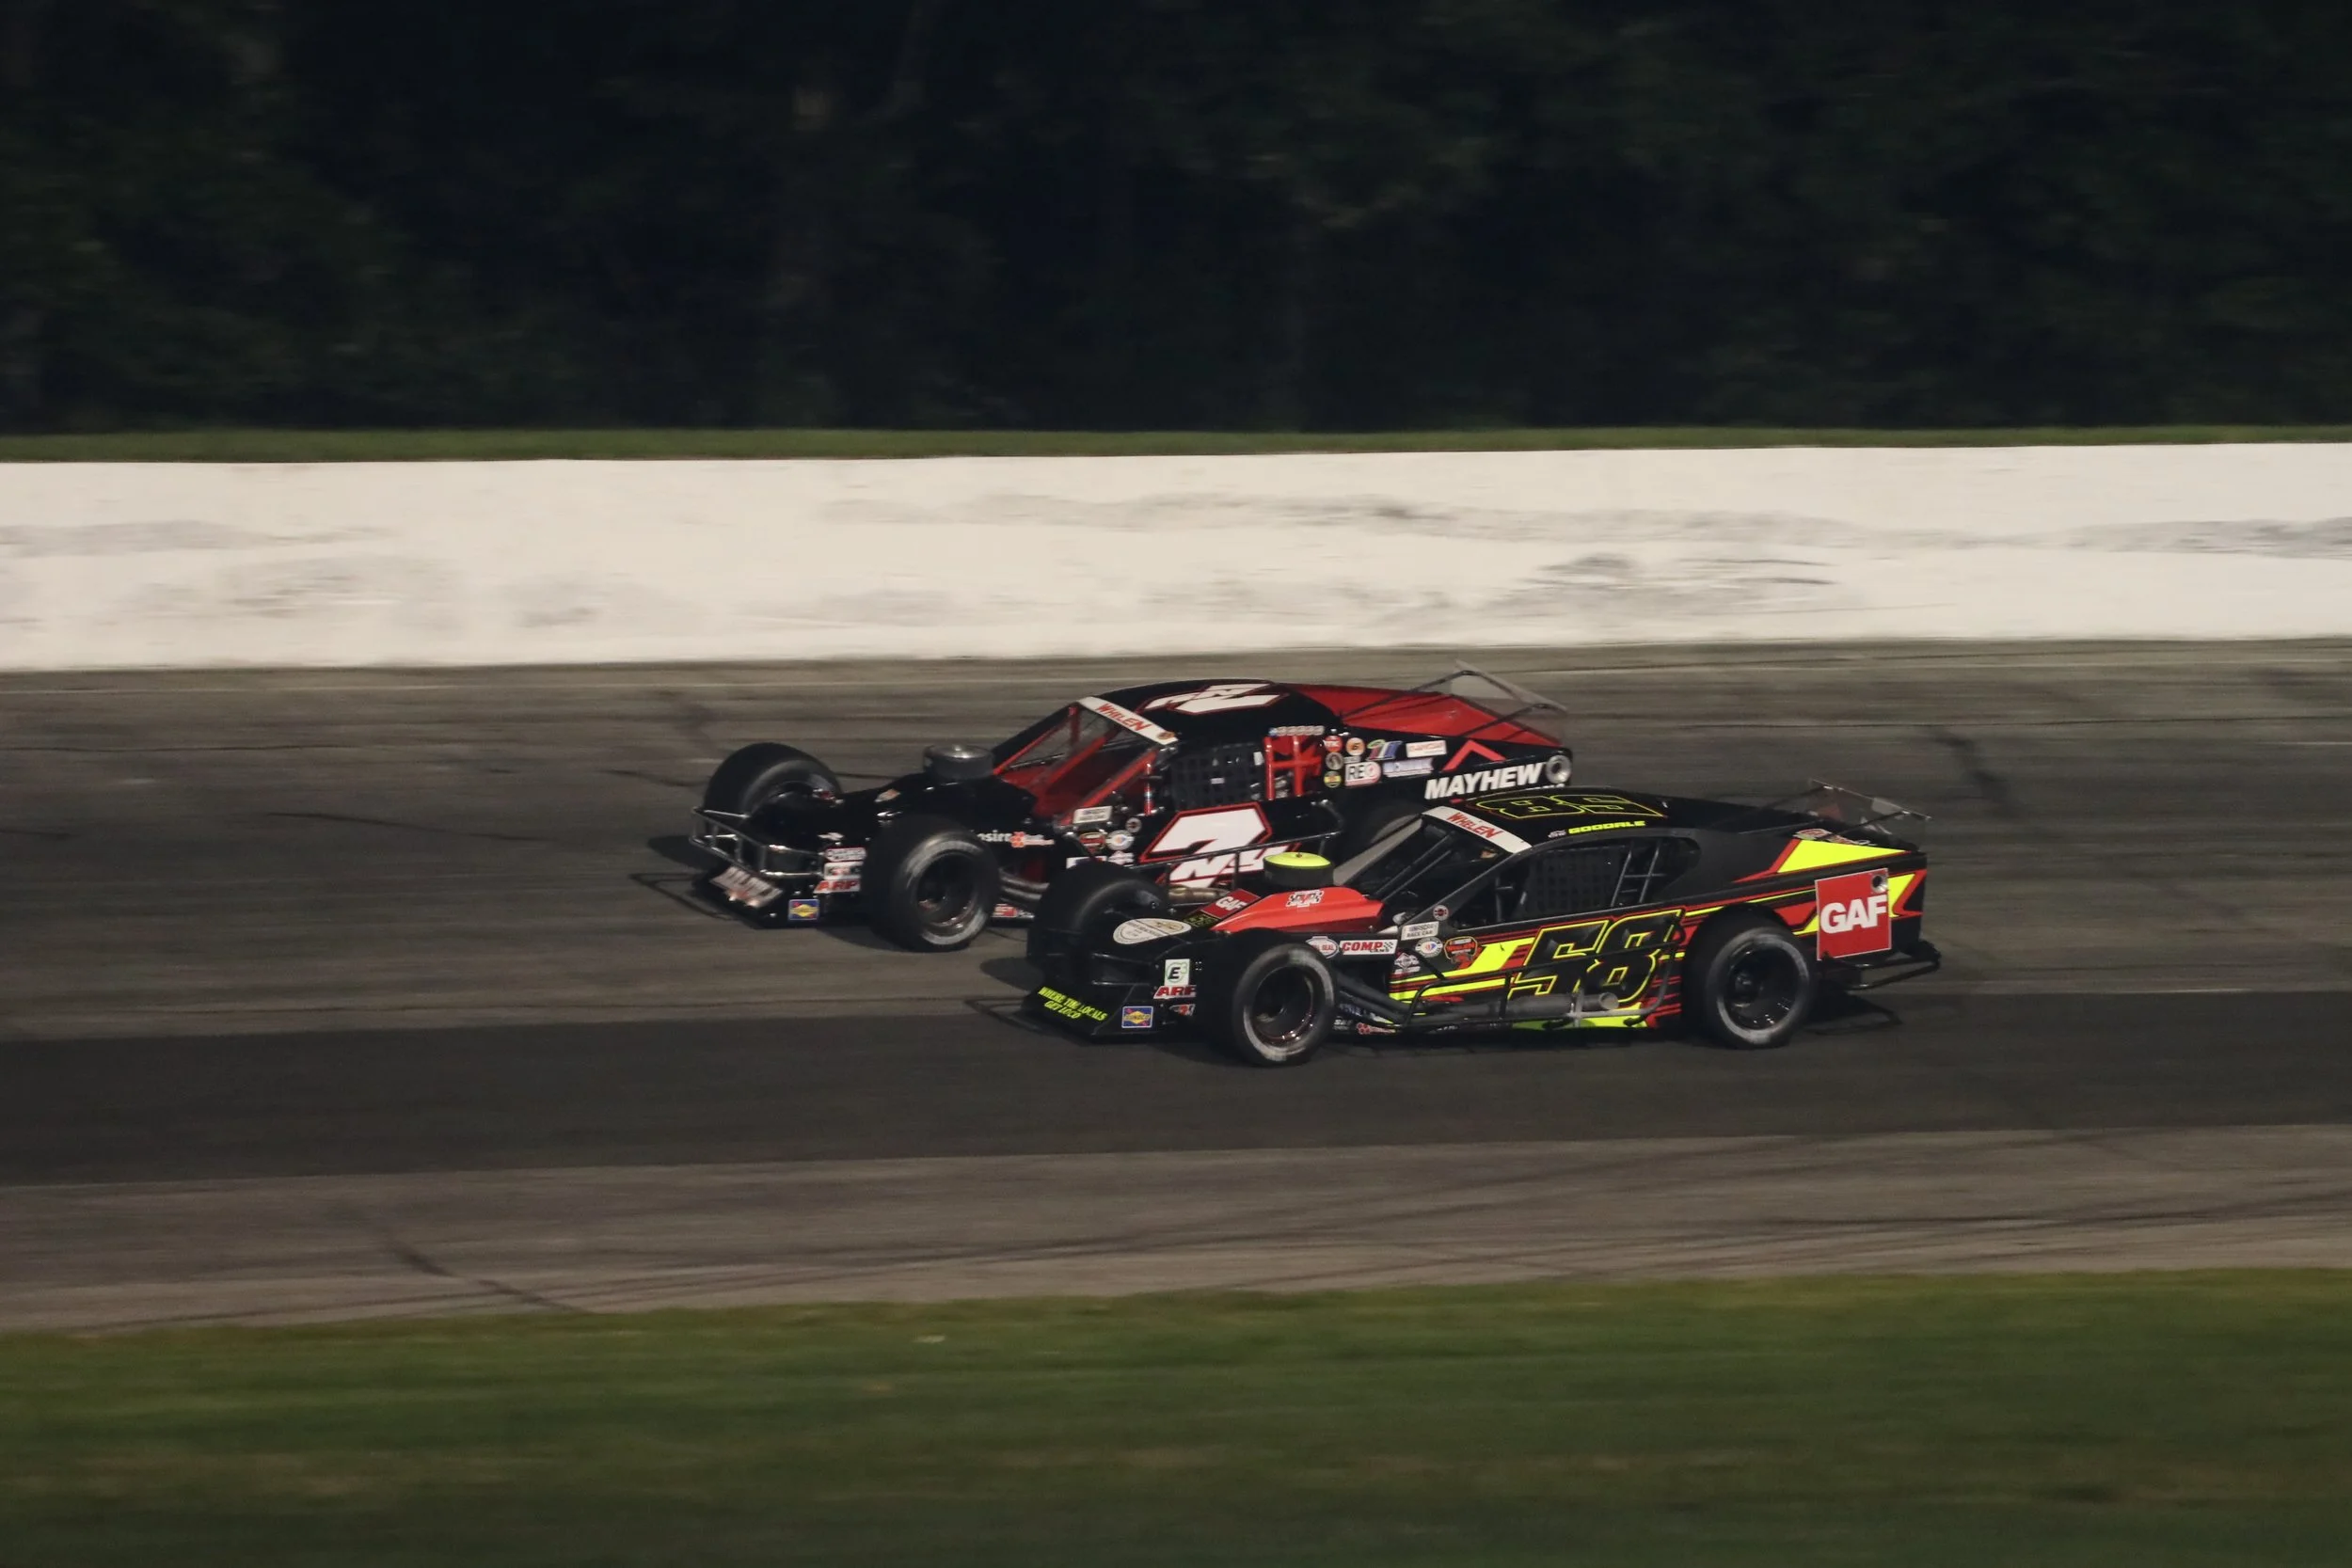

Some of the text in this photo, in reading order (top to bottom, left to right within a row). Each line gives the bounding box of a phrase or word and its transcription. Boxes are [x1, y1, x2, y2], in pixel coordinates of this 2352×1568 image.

[1424, 762, 1547, 800] MAYHEW
[1446, 812, 1503, 838] WHELEN
[1216, 895, 1248, 911] GAF
[1820, 895, 1887, 934] GAF
[1342, 942, 1383, 952] COMP
[1507, 909, 1682, 1004] 58
[1038, 986, 1066, 1004] WHERE
[1044, 1000, 1081, 1019] GET LOCO
